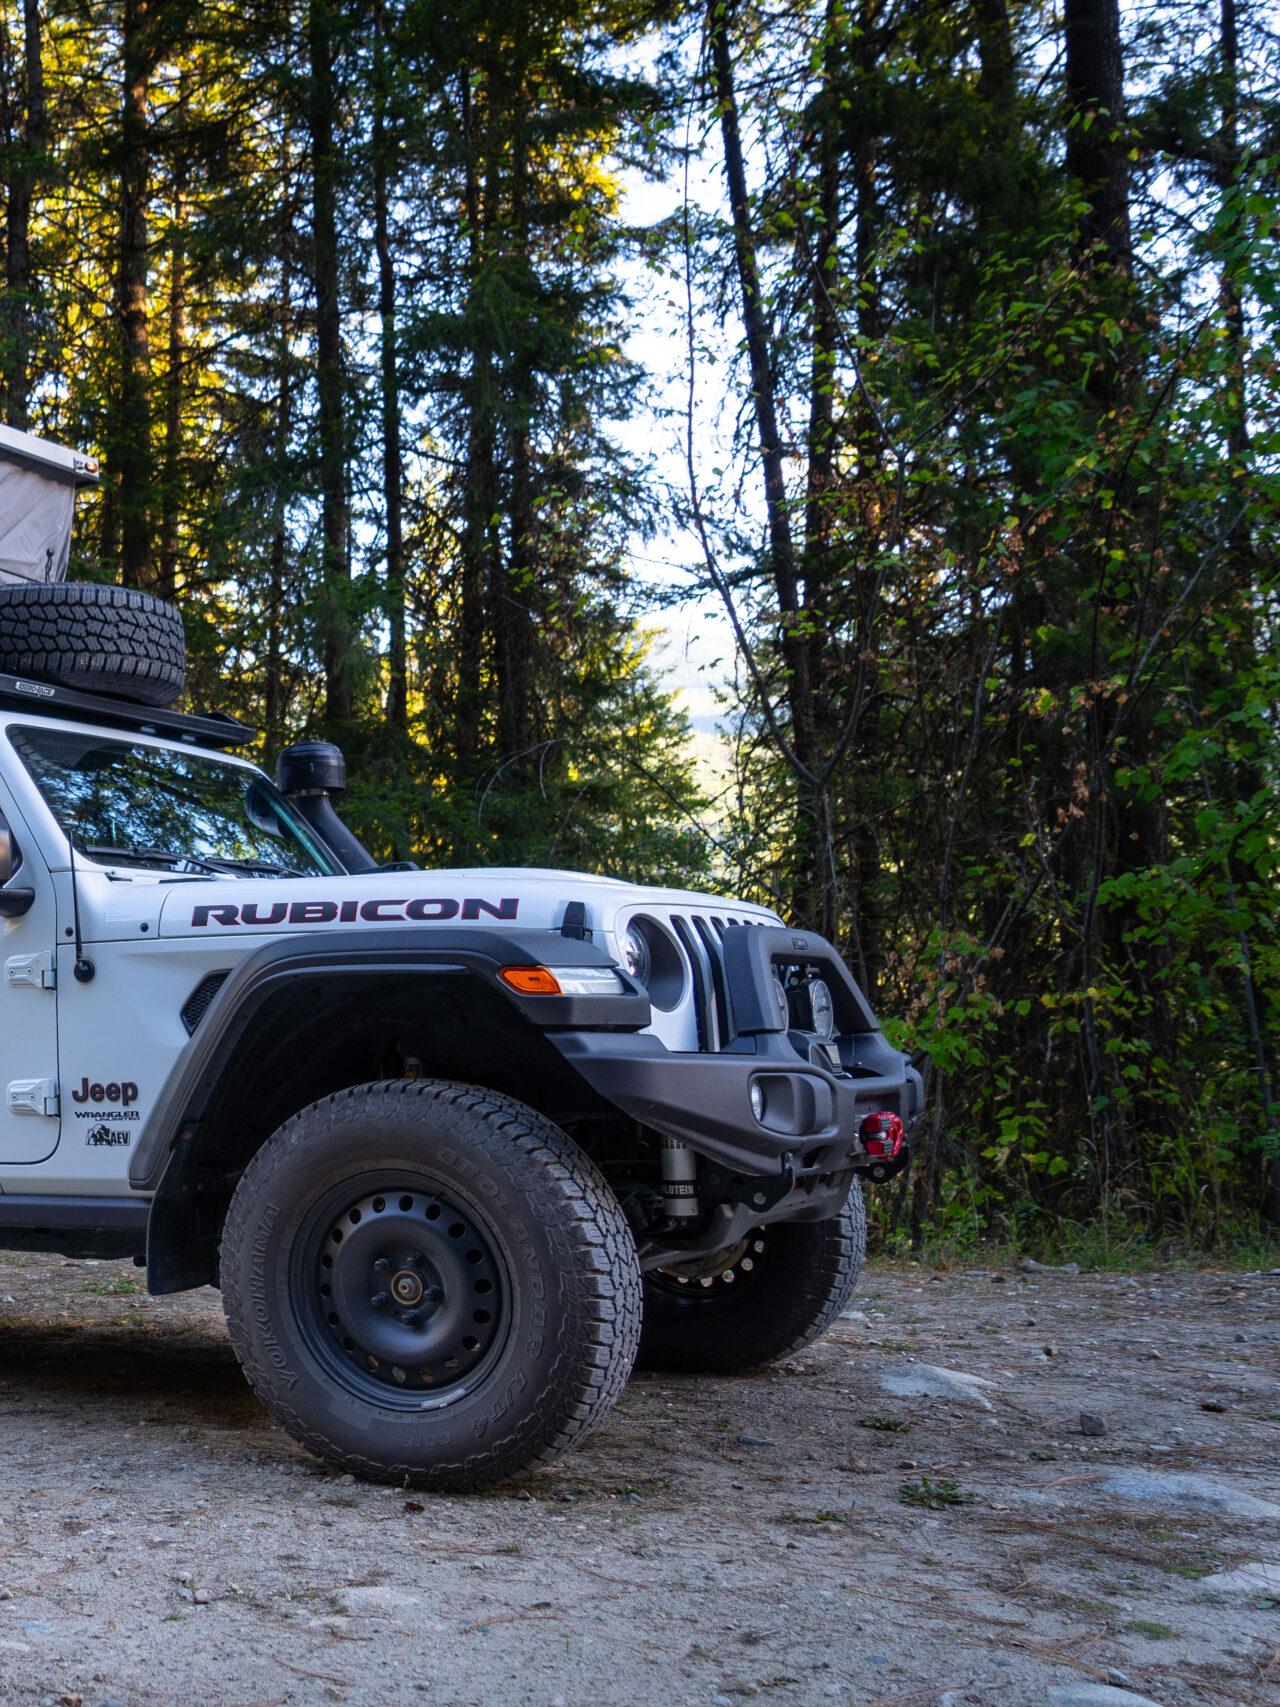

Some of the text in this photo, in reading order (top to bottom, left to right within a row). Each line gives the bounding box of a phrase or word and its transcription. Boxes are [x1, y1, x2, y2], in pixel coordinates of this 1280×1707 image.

[191, 897, 520, 927] RUBICON
[71, 1077, 138, 1106] Jeep
[110, 1132, 129, 1144] AEV
[433, 1144, 546, 1359] GEOLANDAR
[249, 1201, 300, 1392] YOKOHAMA
